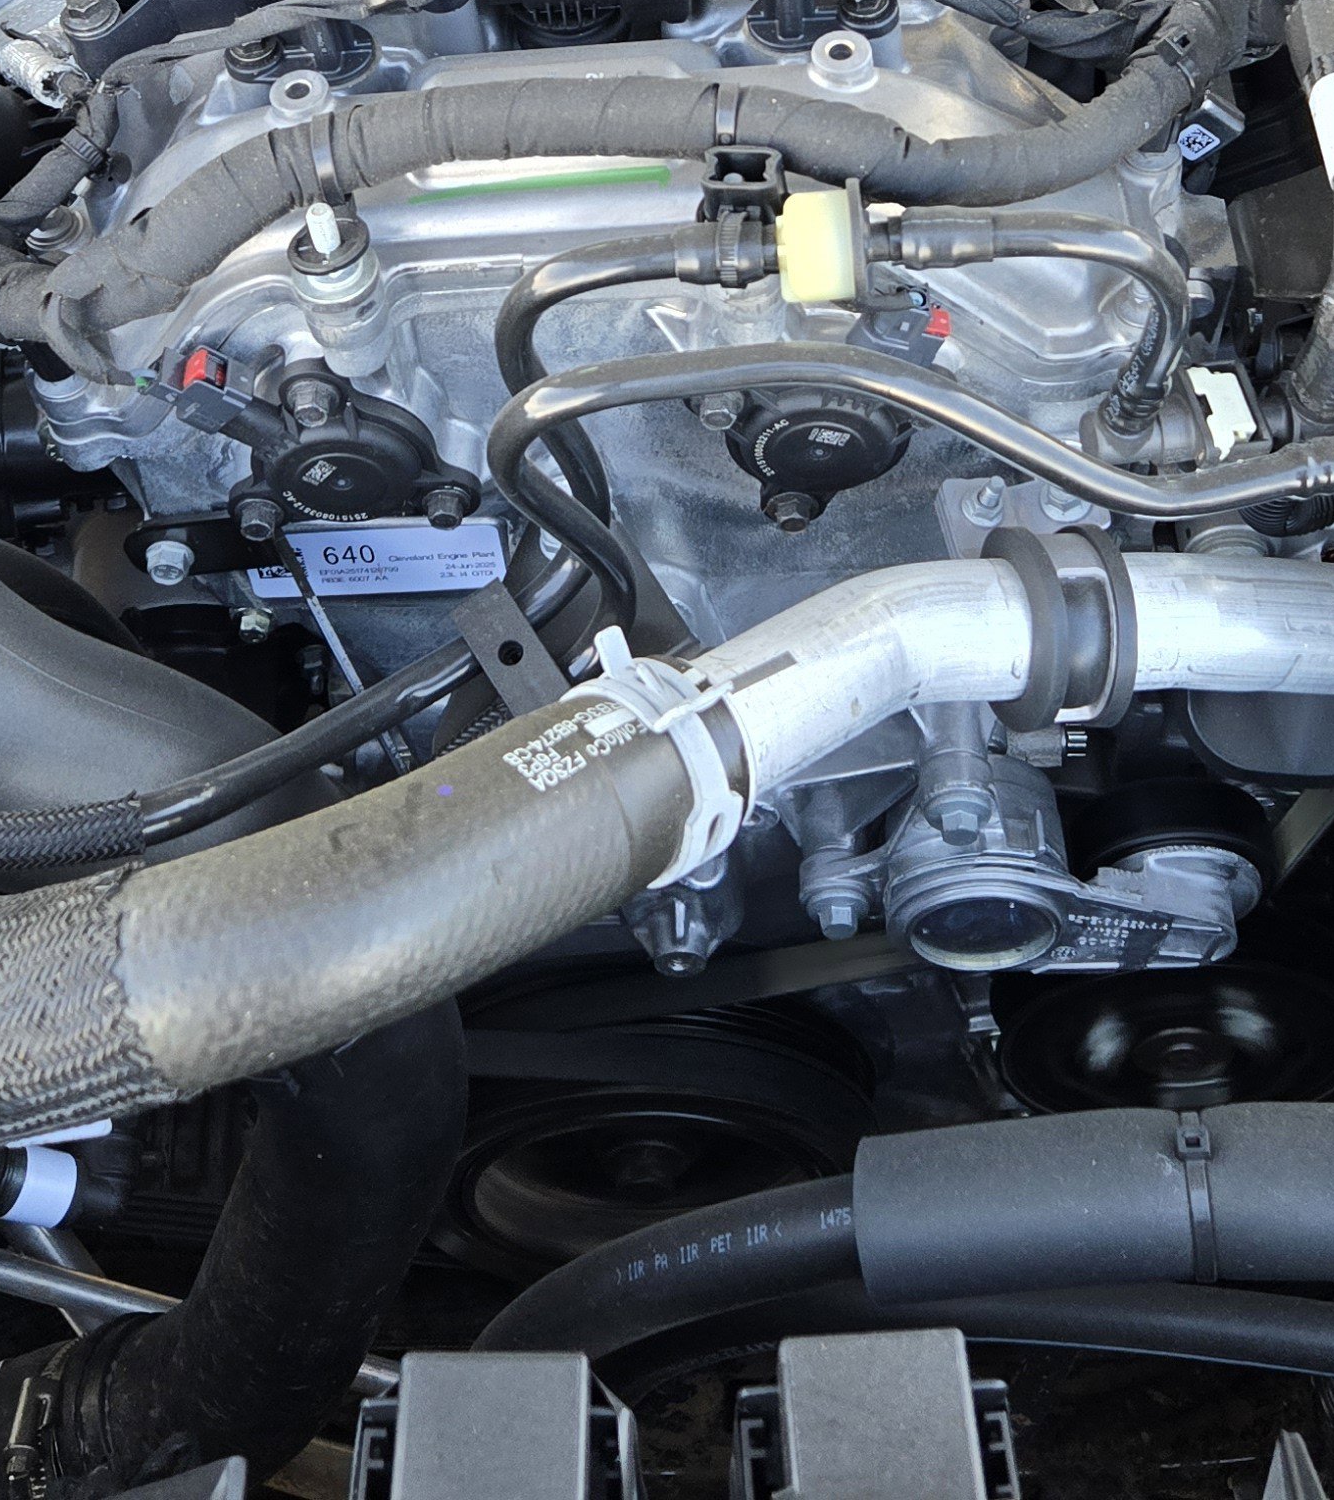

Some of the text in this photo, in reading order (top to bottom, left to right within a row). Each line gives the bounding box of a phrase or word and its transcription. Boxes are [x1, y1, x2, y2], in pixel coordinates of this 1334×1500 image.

[323, 545, 375, 565] 640
[388, 553, 434, 562] Cleveland
[437, 552, 468, 561] Engine
[586, 721, 648, 757] FoMoCo
[517, 747, 561, 778] F6P3
[654, 1253, 668, 1271] PA
[710, 1233, 732, 1255] PET
[819, 1207, 852, 1231] 1475
